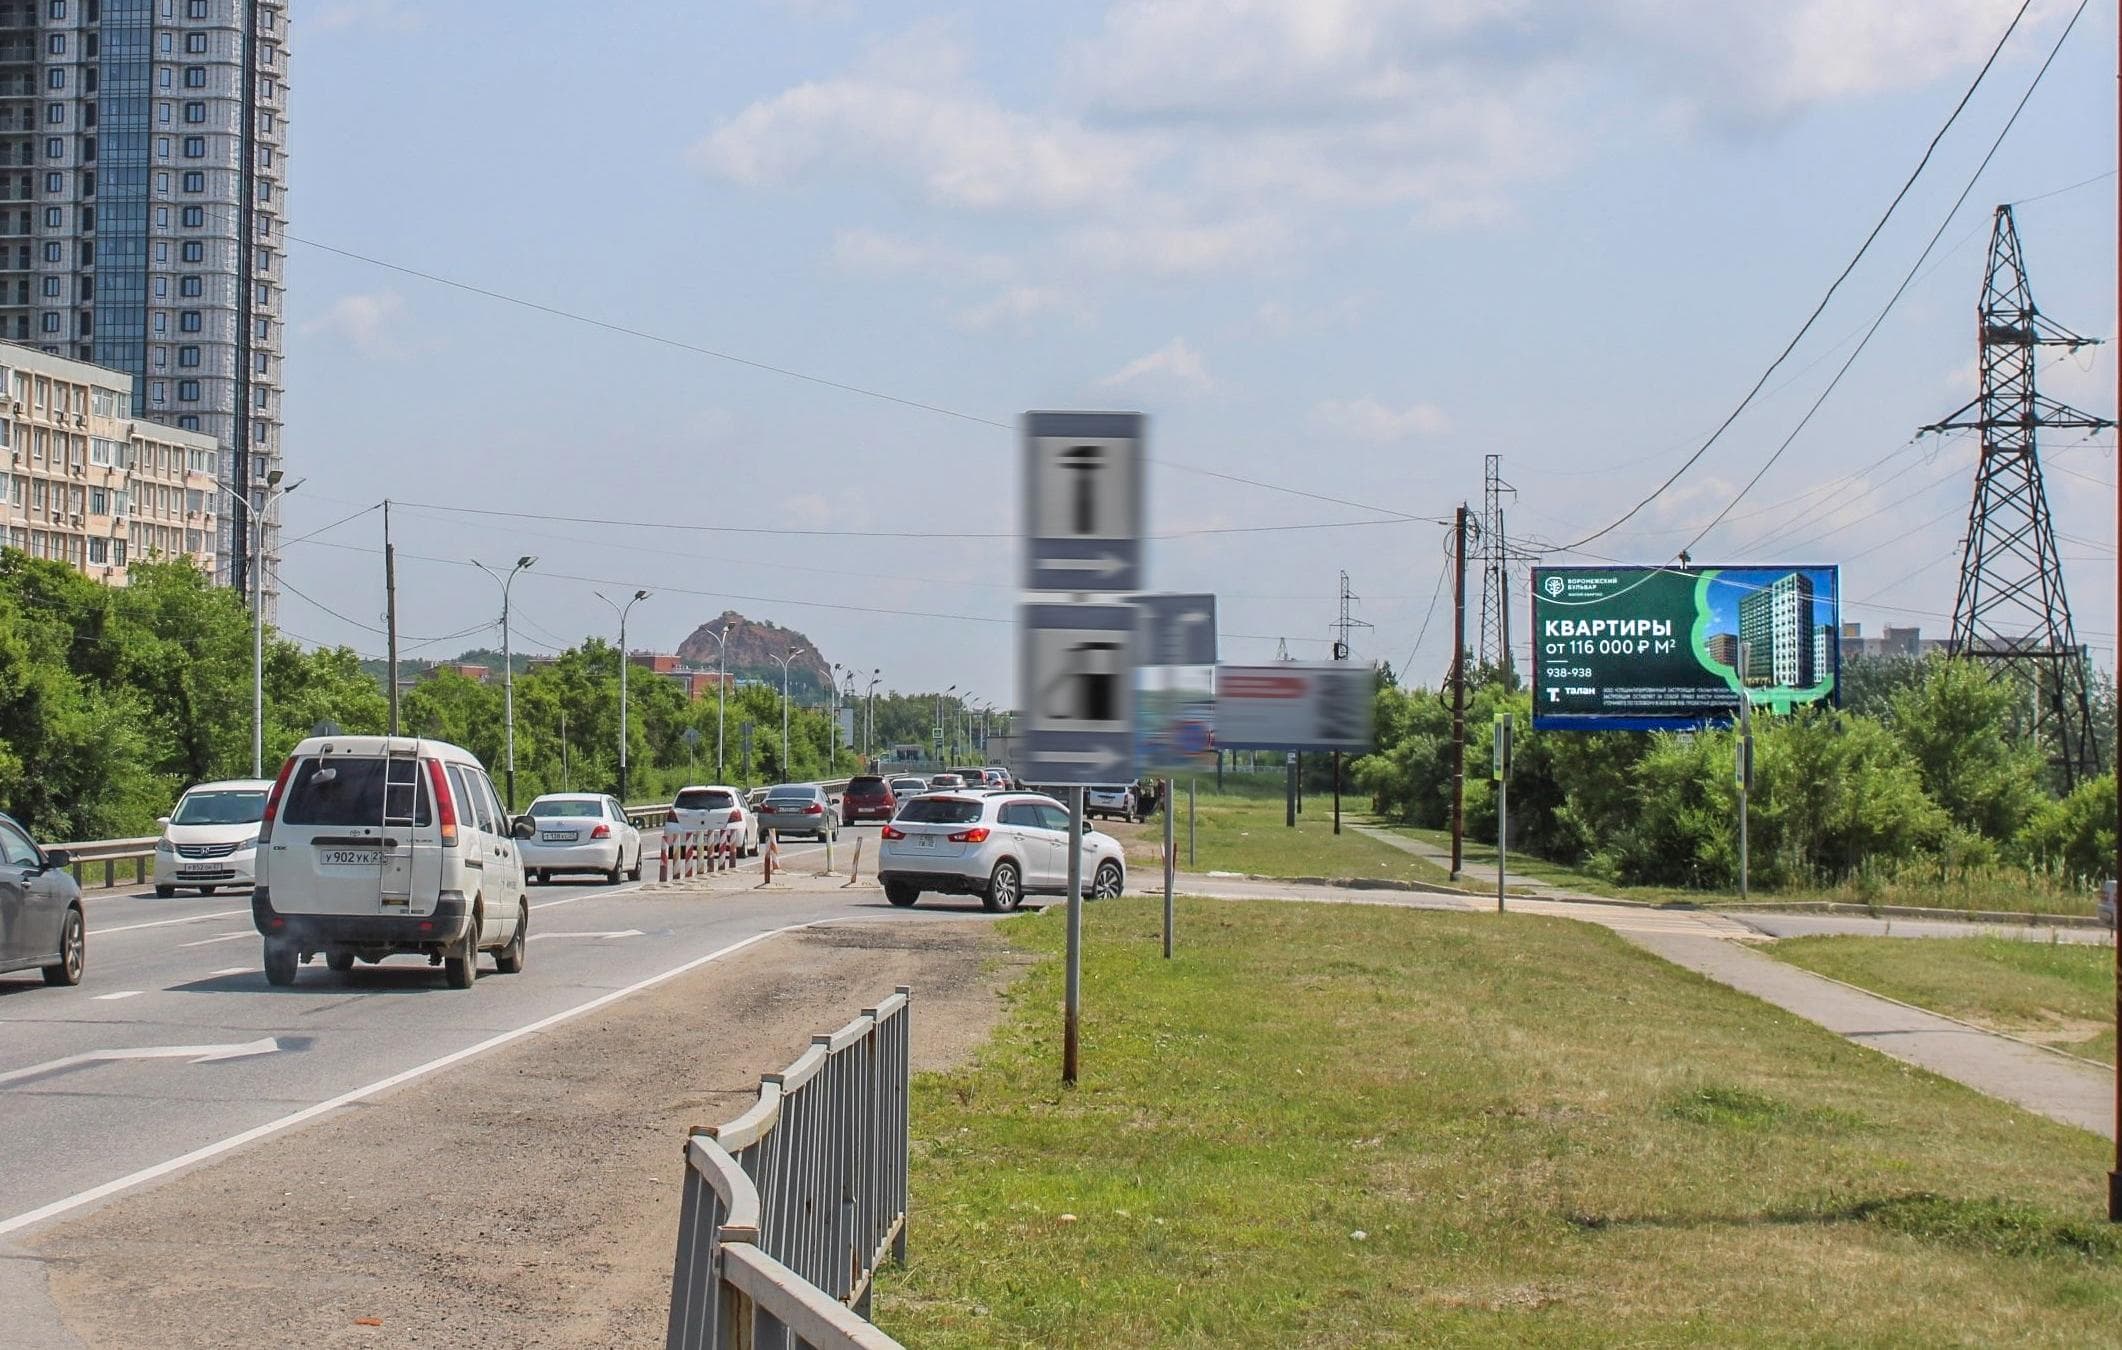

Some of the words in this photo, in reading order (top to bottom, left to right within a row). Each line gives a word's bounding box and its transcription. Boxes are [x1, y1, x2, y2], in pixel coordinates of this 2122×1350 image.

[1545, 620, 1671, 636] КВАРТИРЫ
[1569, 640, 1594, 654] 116
[1600, 640, 1633, 654] 000
[1546, 668, 1592, 678] 938-938
